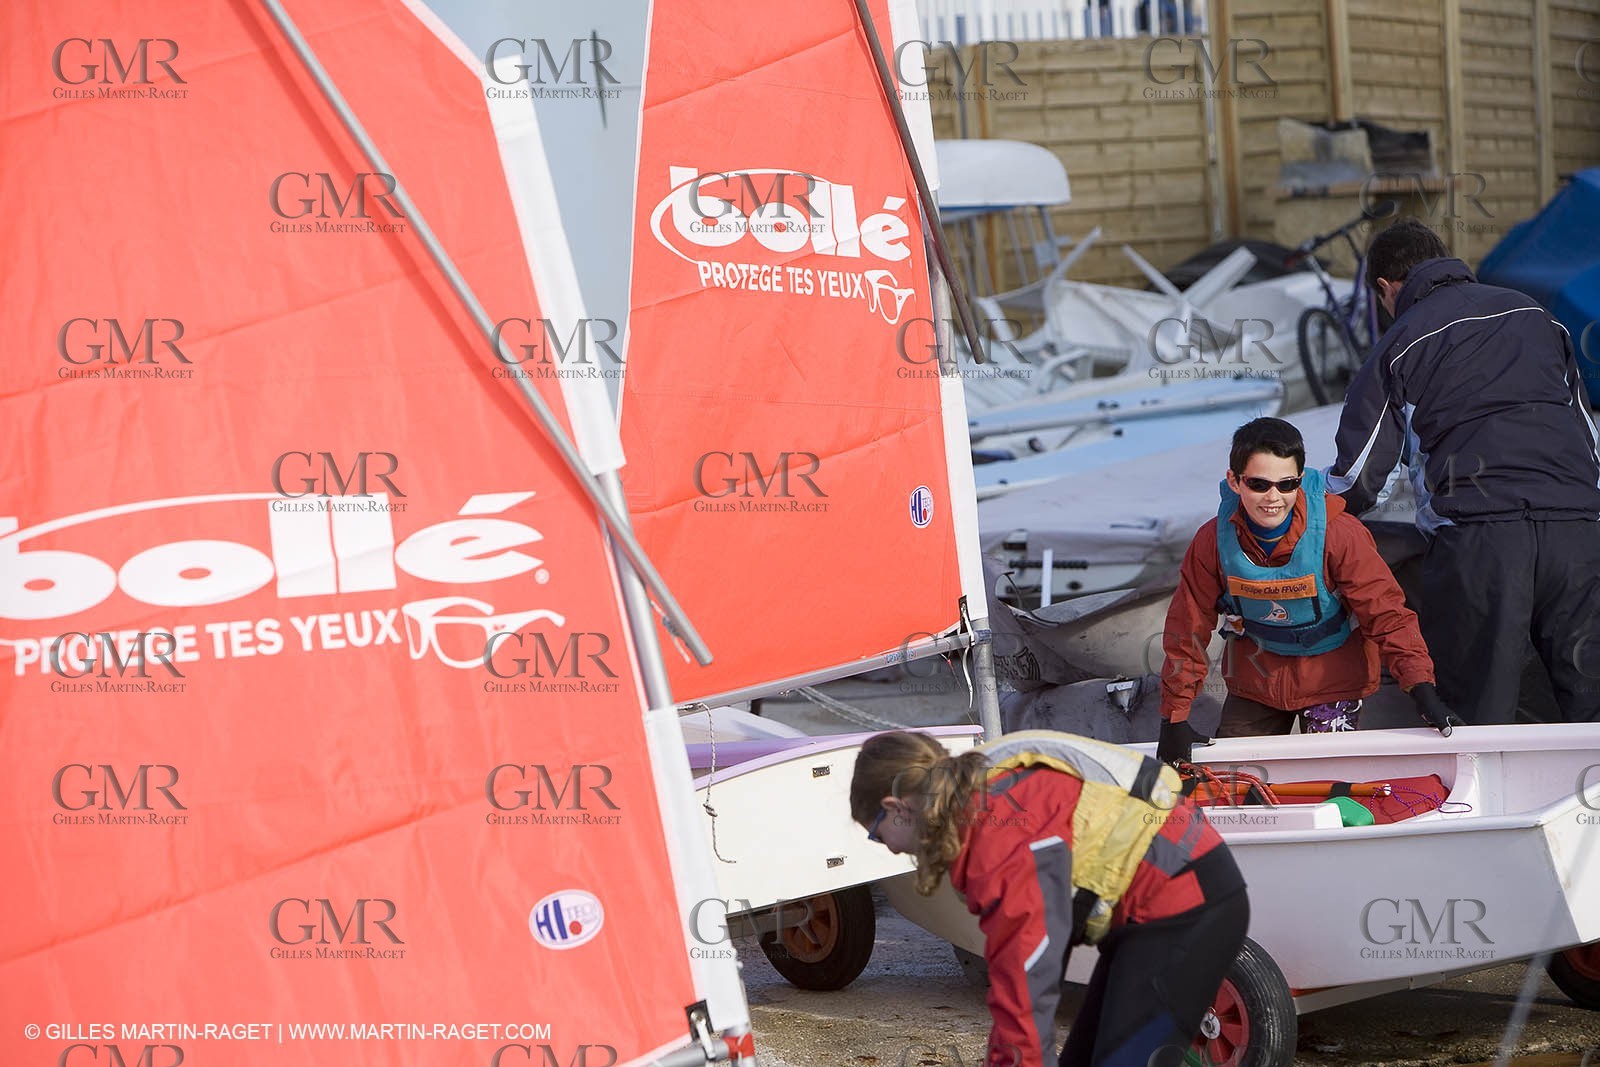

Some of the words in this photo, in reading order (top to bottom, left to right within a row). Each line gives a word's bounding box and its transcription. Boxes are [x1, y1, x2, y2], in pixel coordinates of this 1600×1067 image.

[698, 261, 784, 293] PROTEGE
[786, 266, 814, 295] TES
[817, 269, 866, 299] YEUX
[1263, 586, 1280, 595] Club
[14, 625, 200, 676] PROTEGE
[206, 618, 283, 659] TES
[290, 607, 402, 652] YEUX
